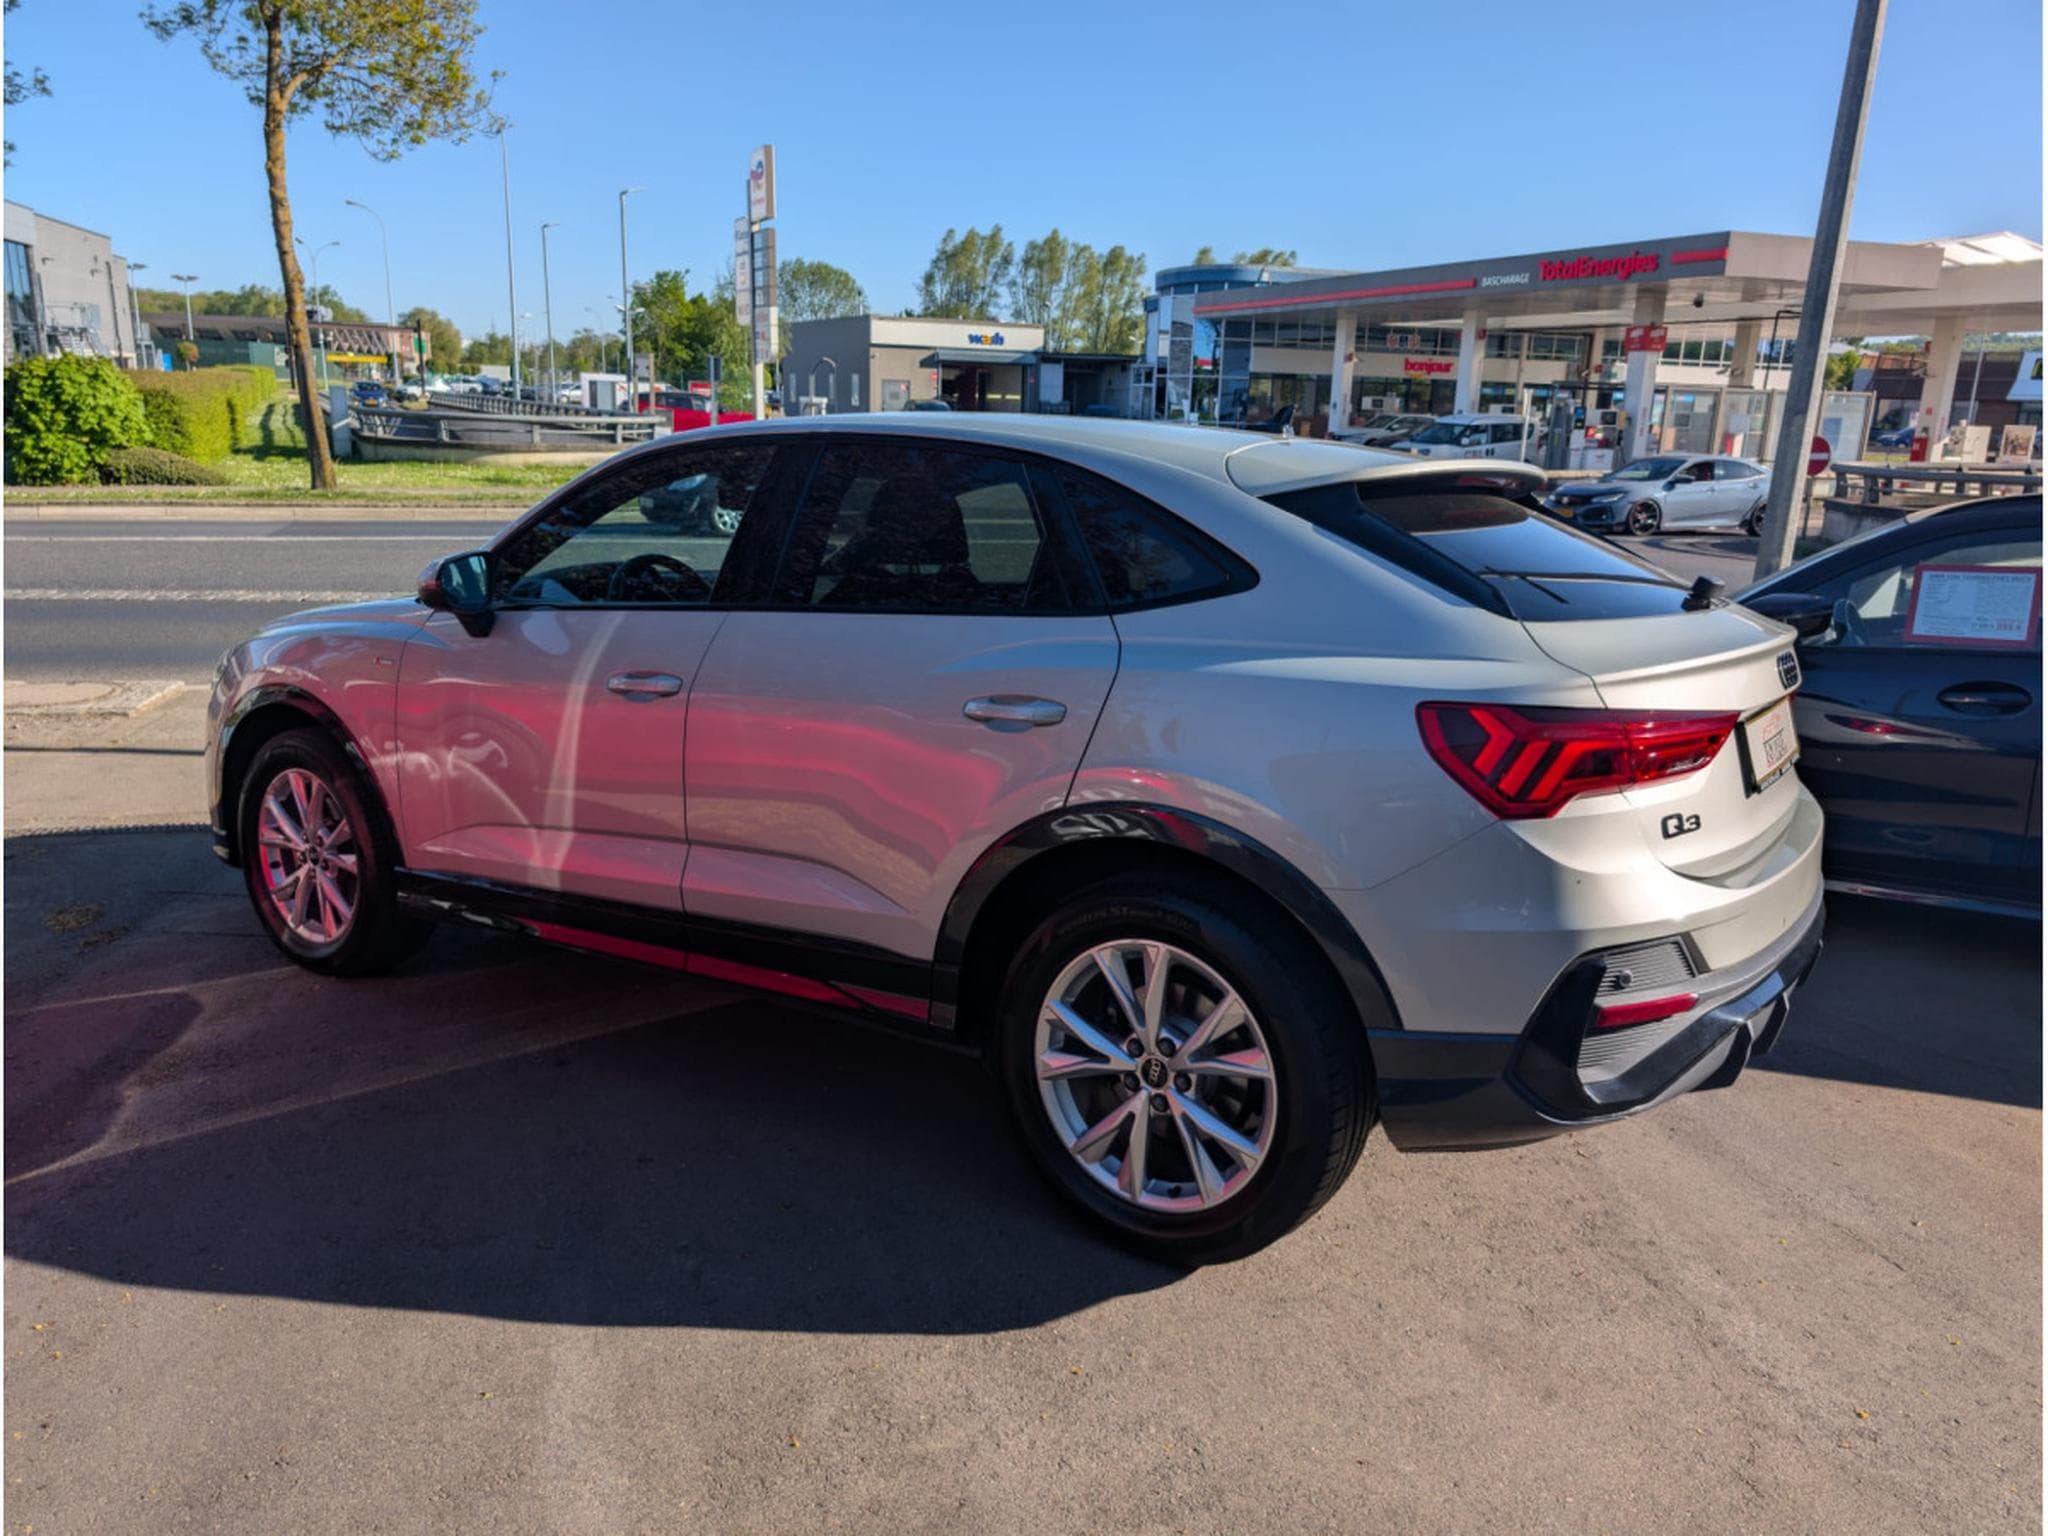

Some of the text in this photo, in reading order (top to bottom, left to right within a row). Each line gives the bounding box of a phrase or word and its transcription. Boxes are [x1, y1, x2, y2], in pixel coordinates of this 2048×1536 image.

[1538, 251, 1660, 282] TotalEnergies
[1404, 358, 1455, 376] bonjour
[1661, 813, 1701, 840] Q3
